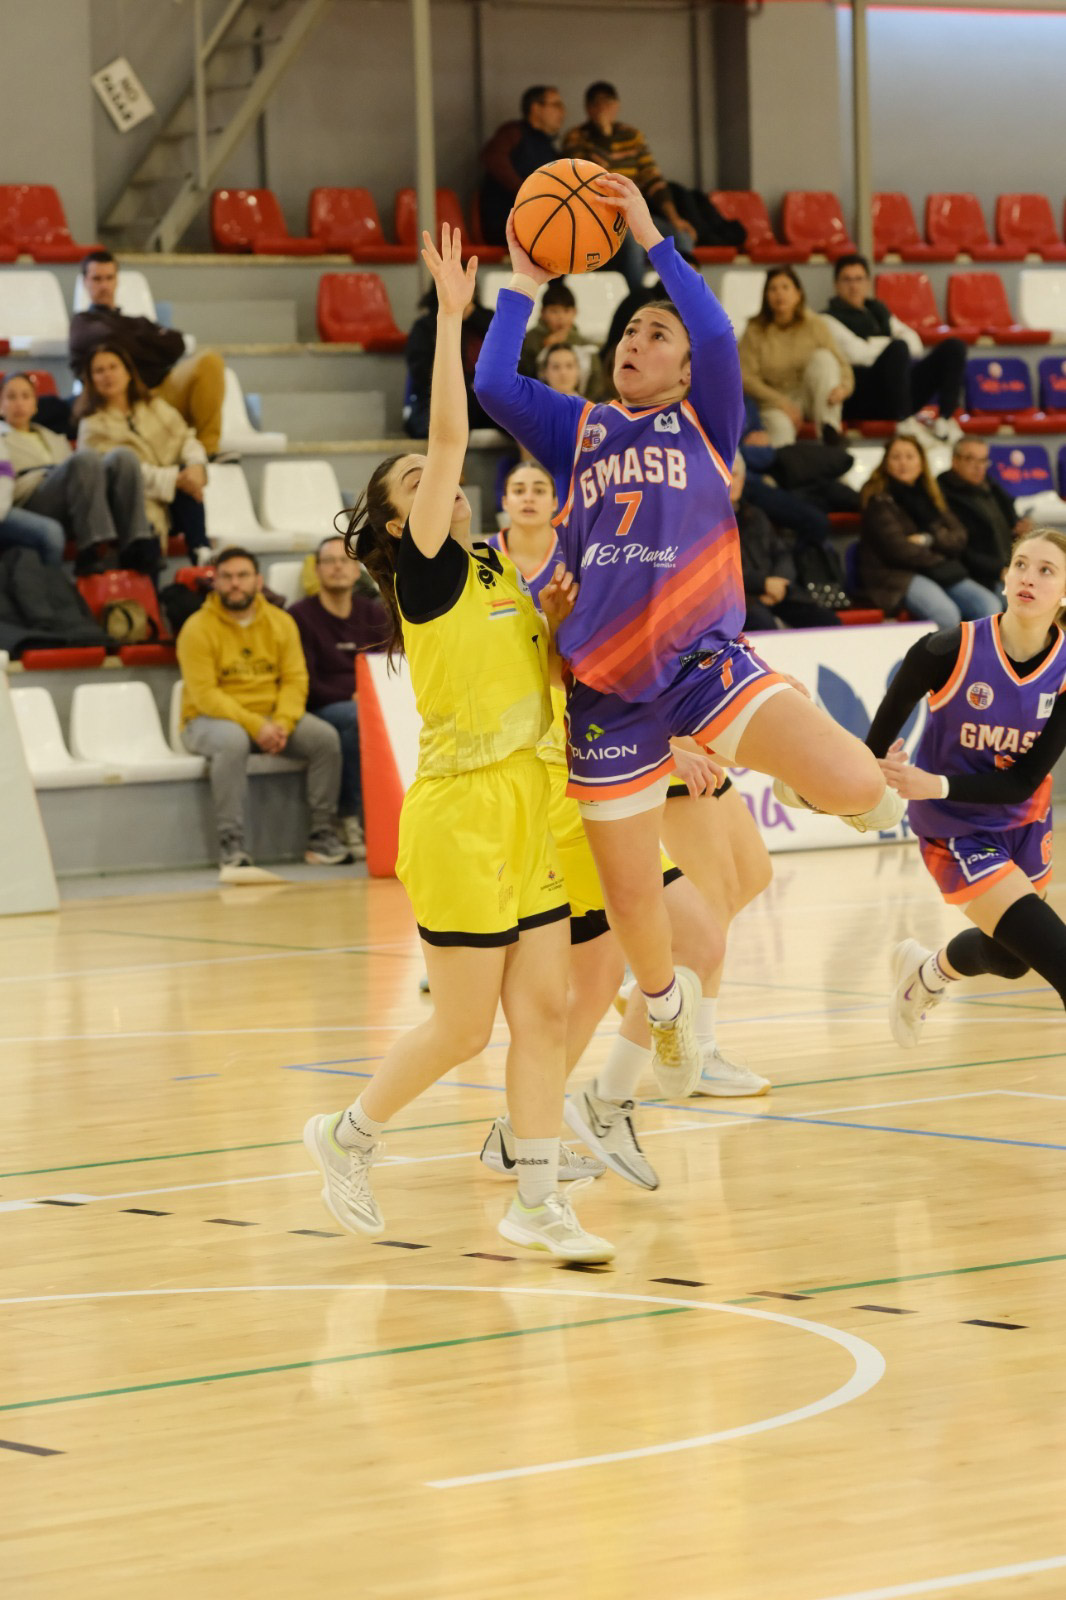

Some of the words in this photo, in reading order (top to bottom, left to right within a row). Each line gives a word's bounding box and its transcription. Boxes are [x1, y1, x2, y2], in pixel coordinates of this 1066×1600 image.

[579, 446, 688, 509] GMASB
[614, 490, 643, 537] 7
[596, 544, 620, 566] El
[573, 744, 638, 760] PLAION
[960, 722, 1042, 754] GMAS
